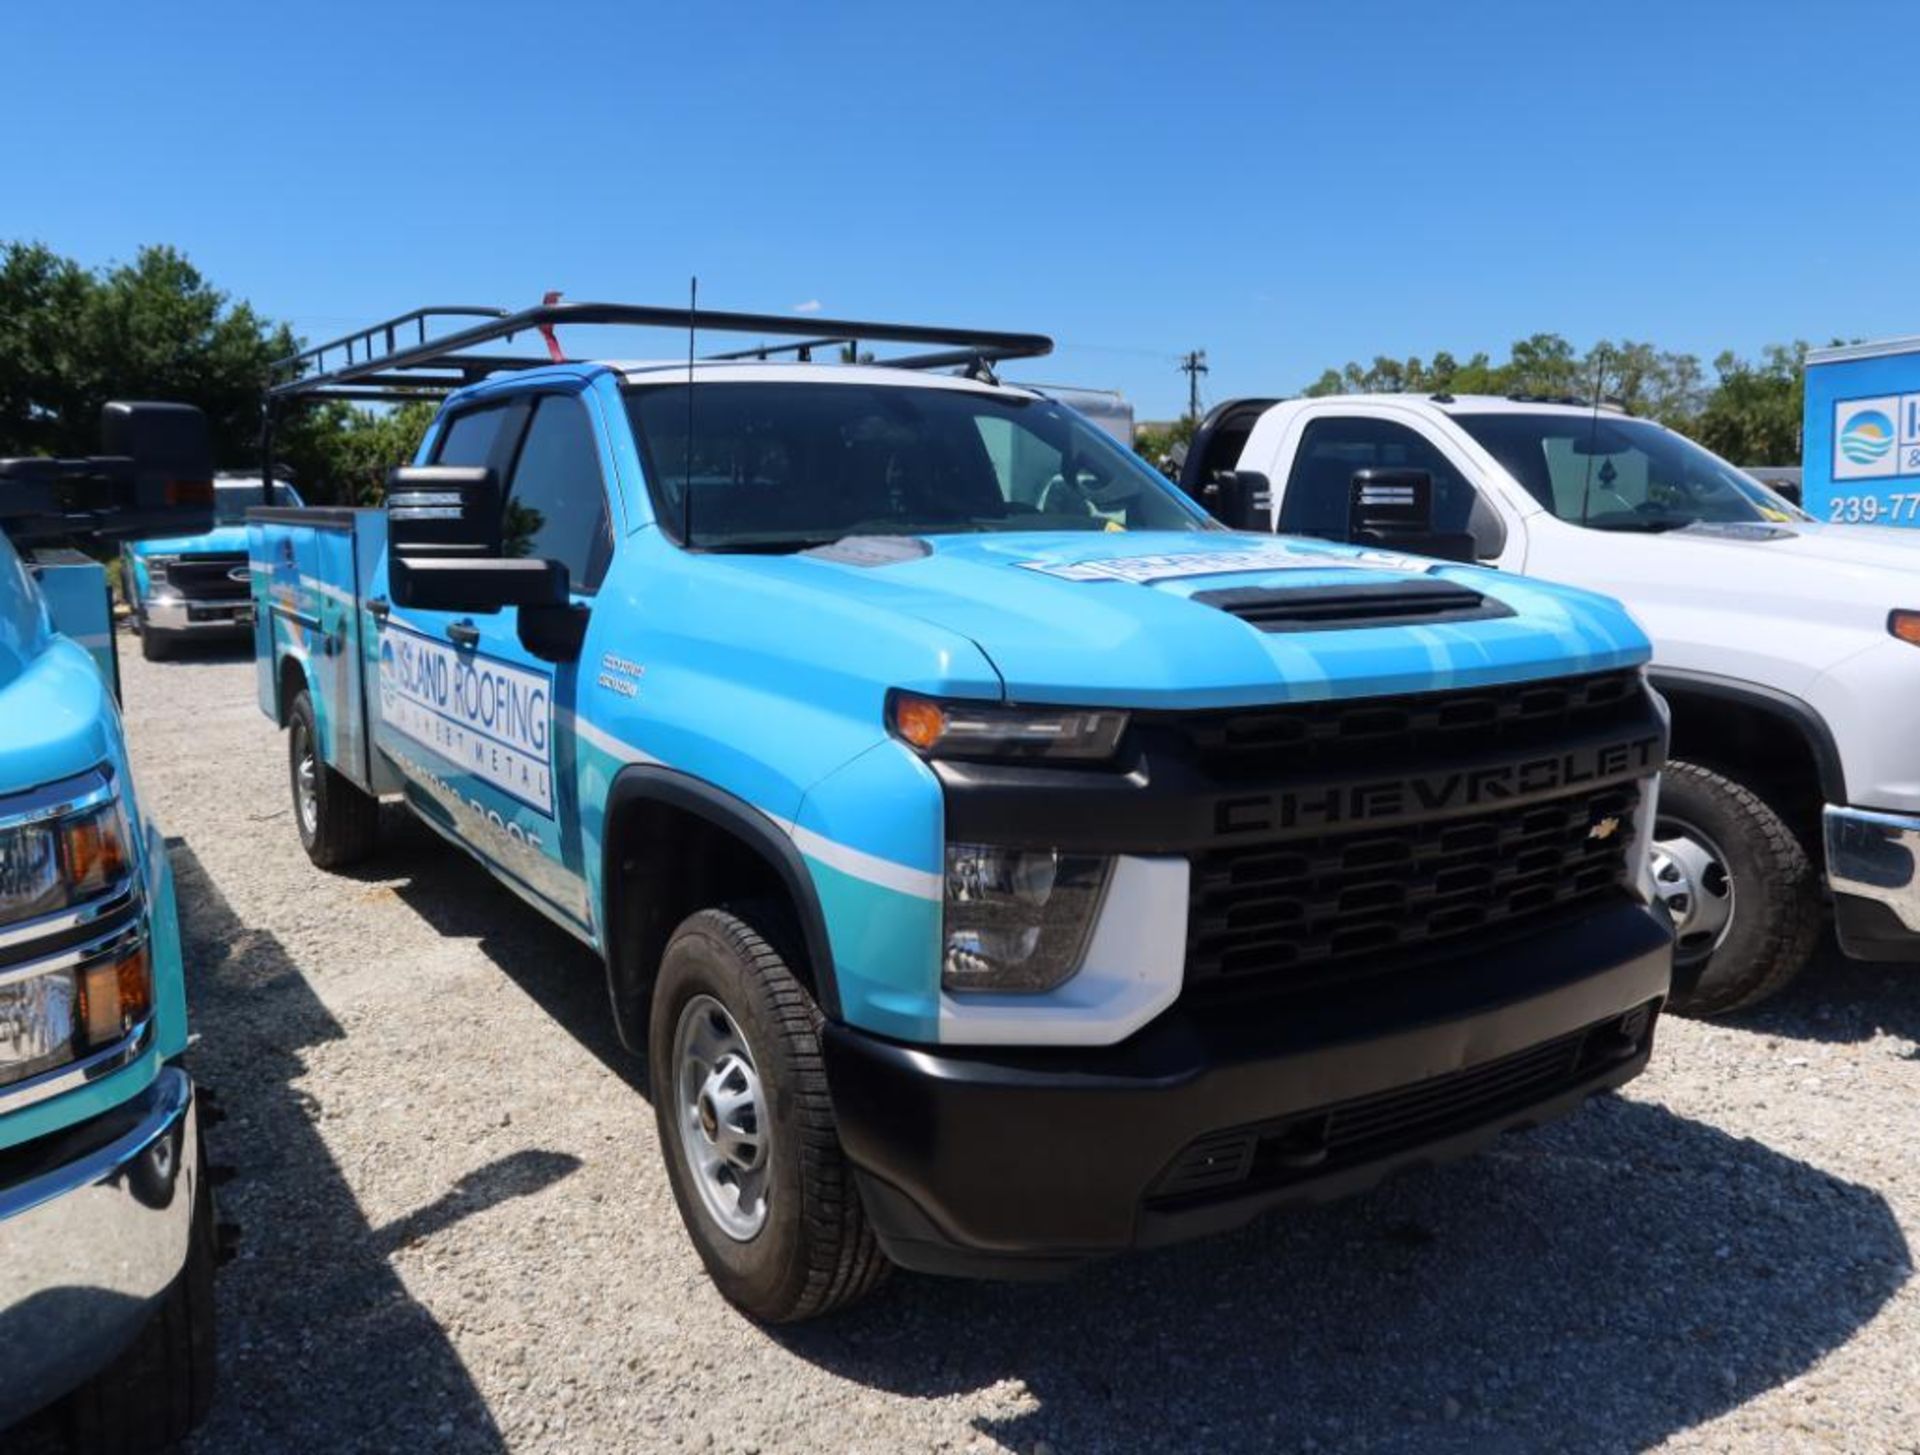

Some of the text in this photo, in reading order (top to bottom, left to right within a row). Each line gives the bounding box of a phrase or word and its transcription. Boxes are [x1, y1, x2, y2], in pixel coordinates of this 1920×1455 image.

[1908, 401, 1920, 438] I
[399, 640, 545, 750] ISLAND ROOFING
[475, 740, 546, 796] METAL
[1213, 735, 1660, 835] CHEVROLET
